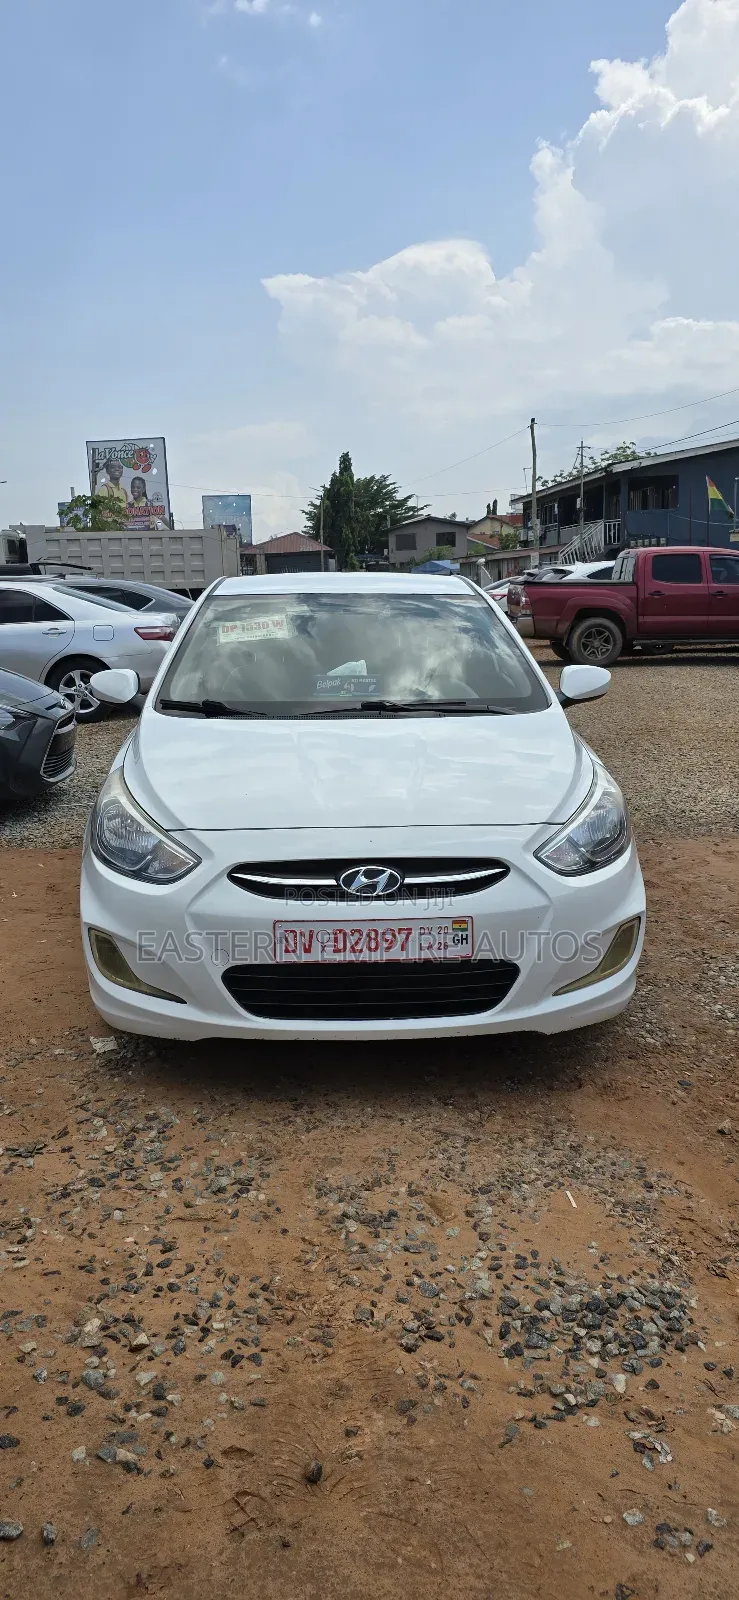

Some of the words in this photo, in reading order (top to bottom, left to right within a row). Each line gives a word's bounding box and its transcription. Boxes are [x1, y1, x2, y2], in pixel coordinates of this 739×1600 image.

[419, 926, 433, 935] DV
[437, 925, 449, 935] 20
[283, 929, 315, 954] DV
[332, 927, 413, 954] D2897
[452, 933, 469, 945] GH
[437, 941, 449, 951] 26
